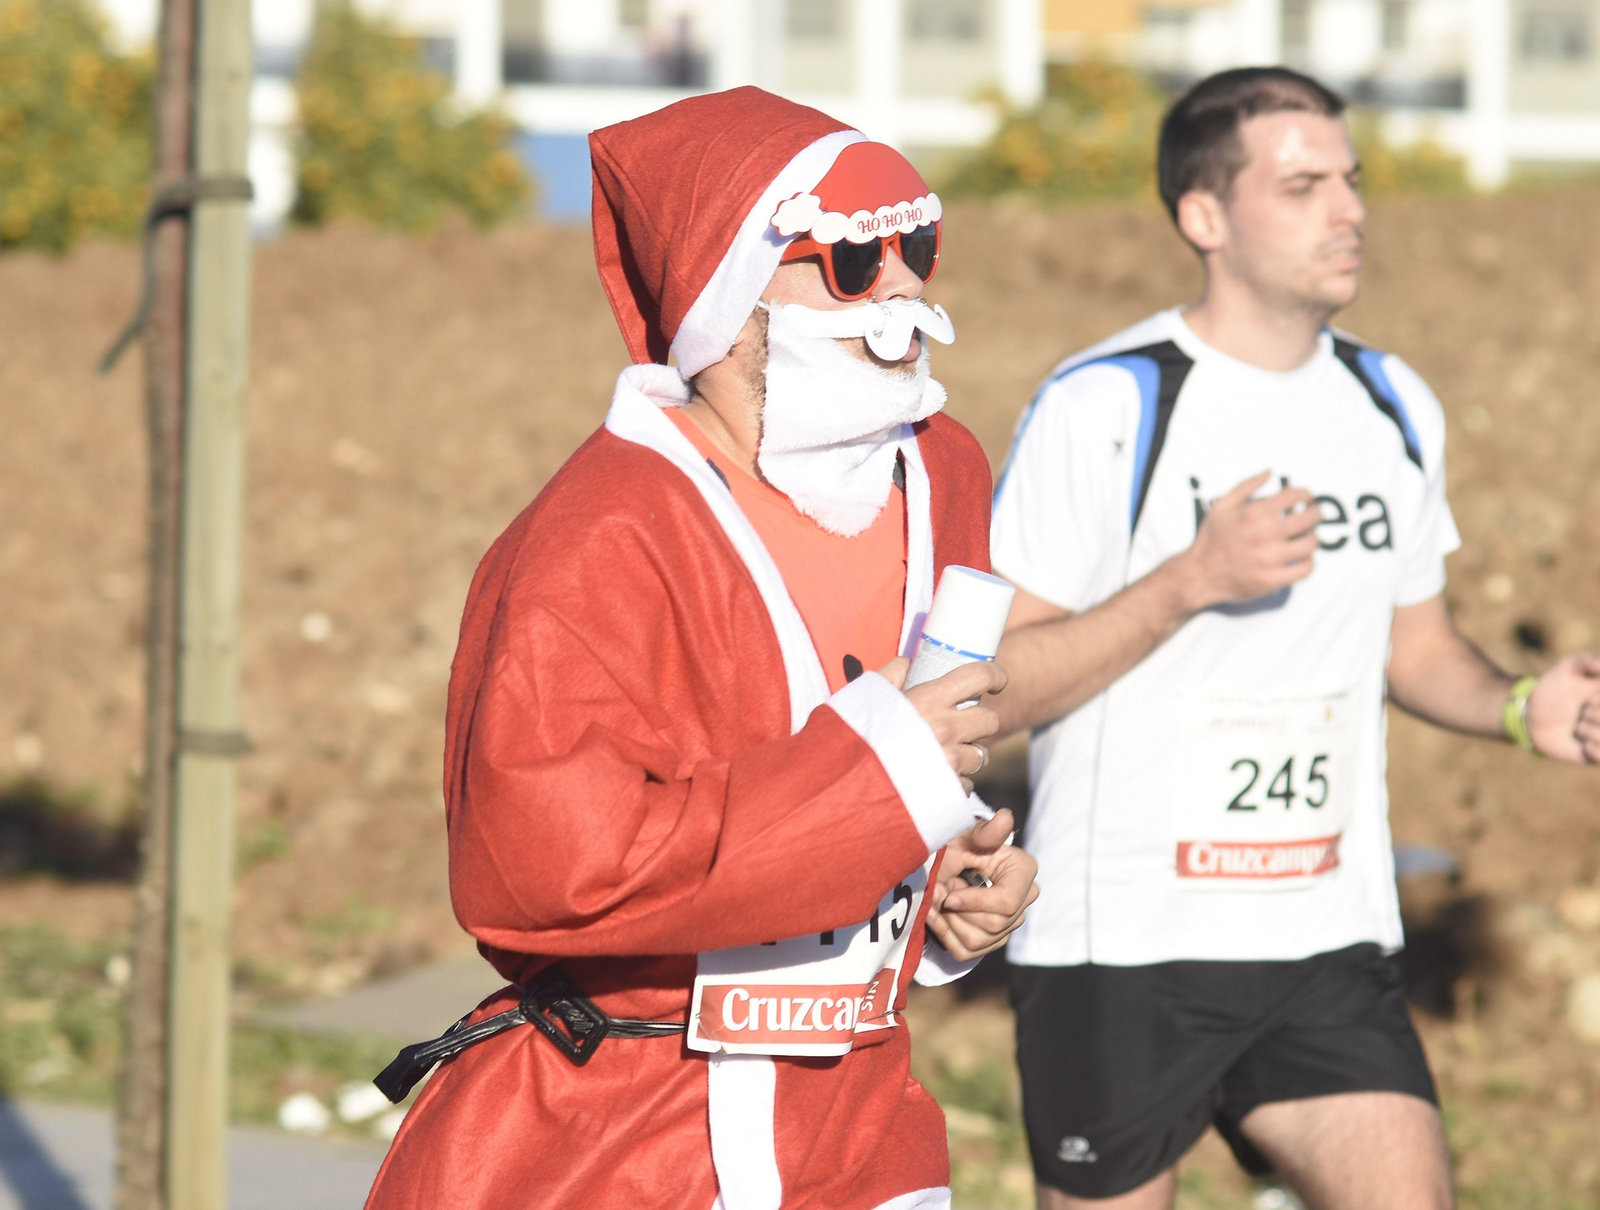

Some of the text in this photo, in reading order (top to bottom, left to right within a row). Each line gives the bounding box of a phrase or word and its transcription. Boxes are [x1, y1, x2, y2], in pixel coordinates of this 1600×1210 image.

[857, 207, 923, 234] HO HO HO
[1189, 474, 1393, 552] iea
[1226, 754, 1329, 811] 245
[861, 980, 880, 1012] SIN
